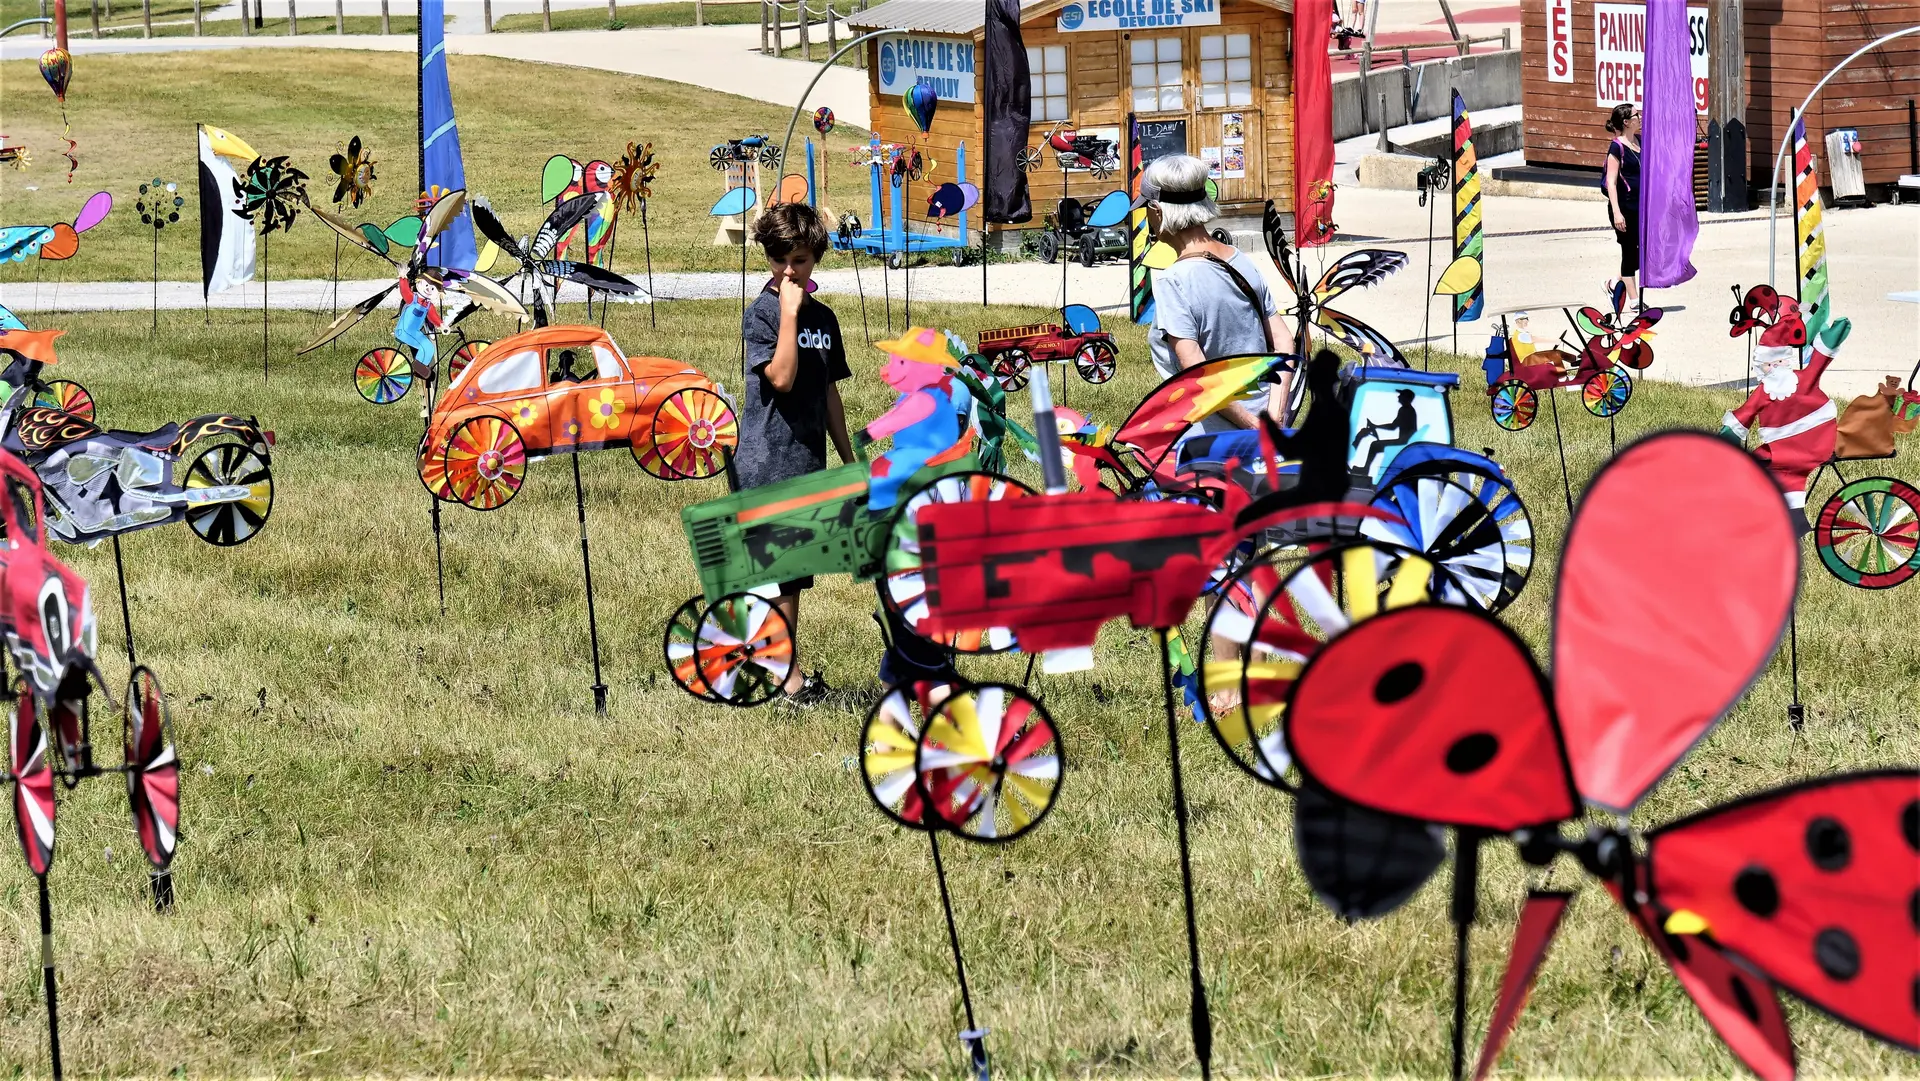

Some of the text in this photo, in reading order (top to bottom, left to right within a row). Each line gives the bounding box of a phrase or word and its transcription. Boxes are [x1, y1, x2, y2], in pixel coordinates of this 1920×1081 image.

[1088, 0, 1214, 18] ECOLE DE SKI
[1119, 14, 1184, 28] DEVOLUY
[1552, 0, 1568, 76] ES
[1600, 12, 1709, 56] PANIN SS
[896, 39, 974, 73] ECOLE DE SK
[1598, 61, 1644, 102] CREPE
[797, 328, 831, 350] dida
